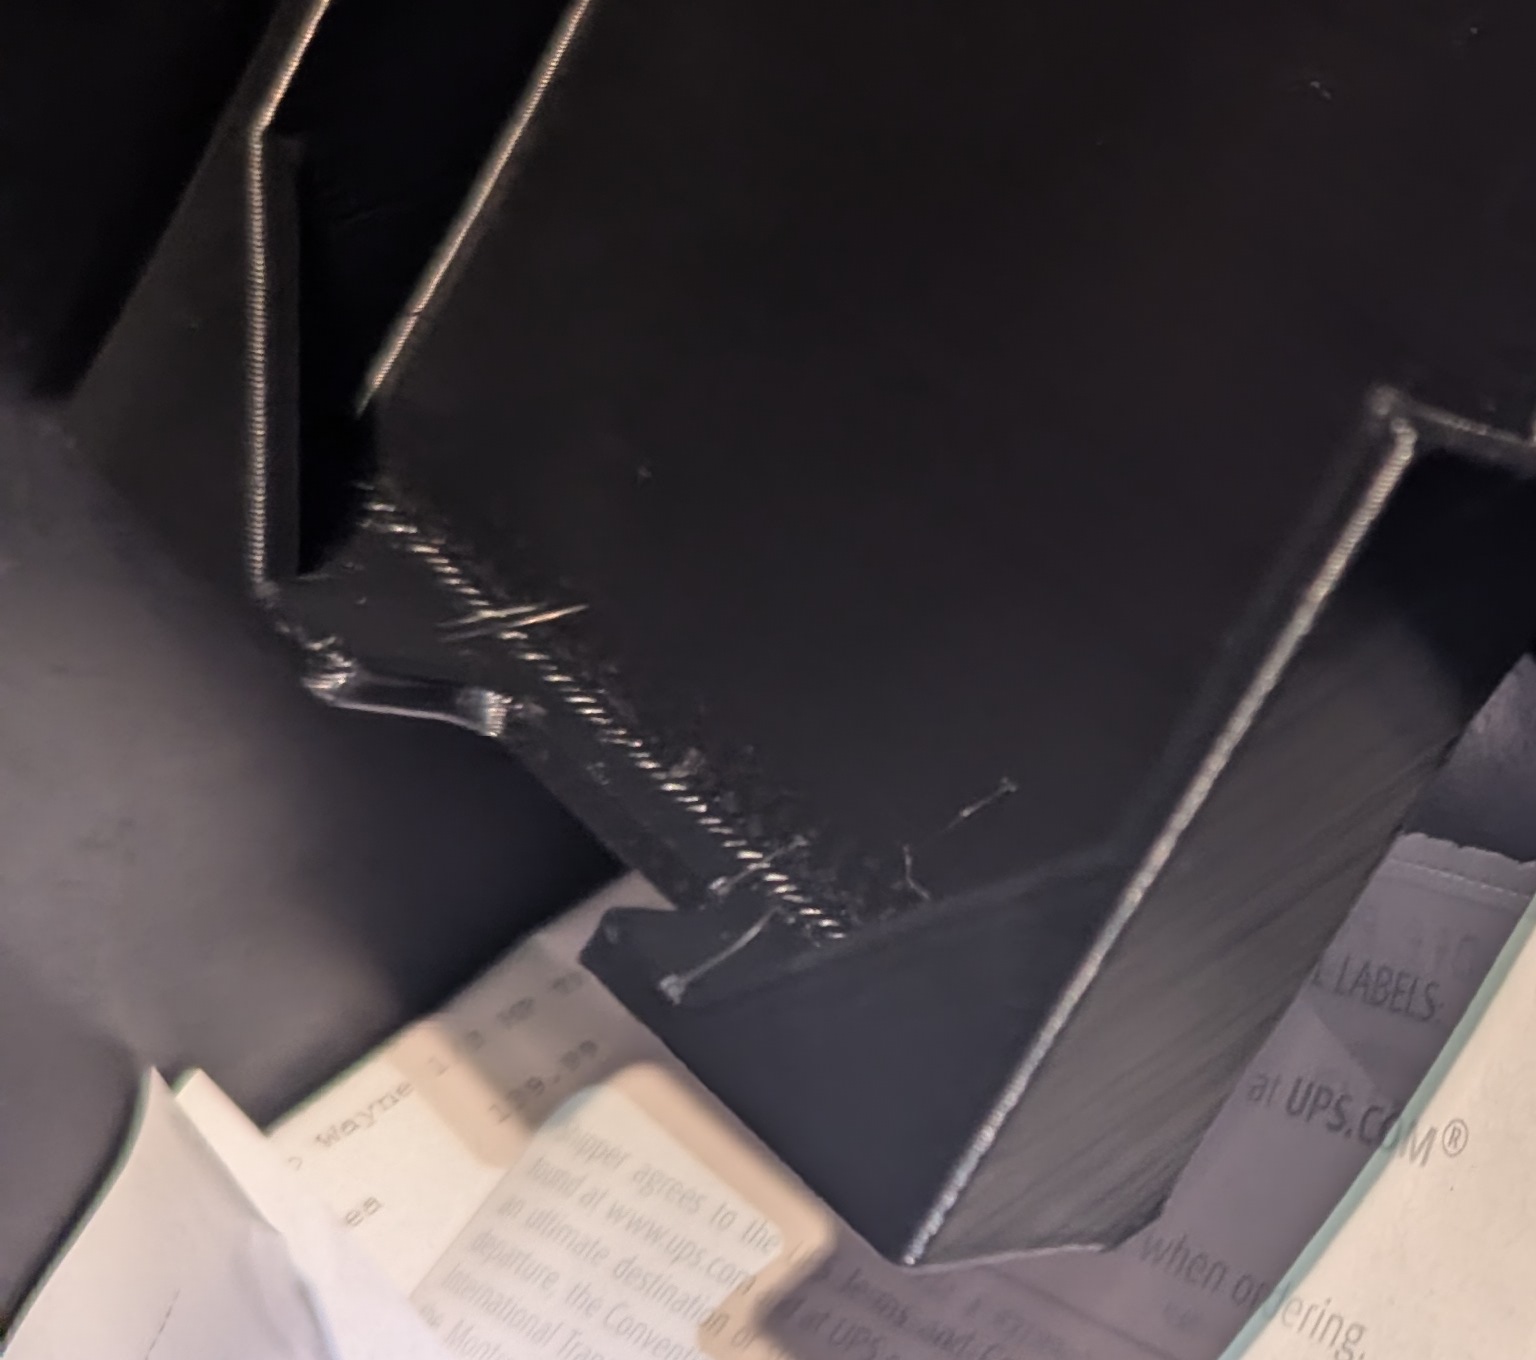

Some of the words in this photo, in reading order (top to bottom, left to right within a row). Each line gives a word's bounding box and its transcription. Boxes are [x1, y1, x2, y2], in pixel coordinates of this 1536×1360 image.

[631, 1161, 708, 1216] agrees
[710, 1200, 739, 1233] to
[523, 1205, 612, 1268] ultimate
[611, 1253, 732, 1339] destination
[564, 1278, 604, 1320] the
